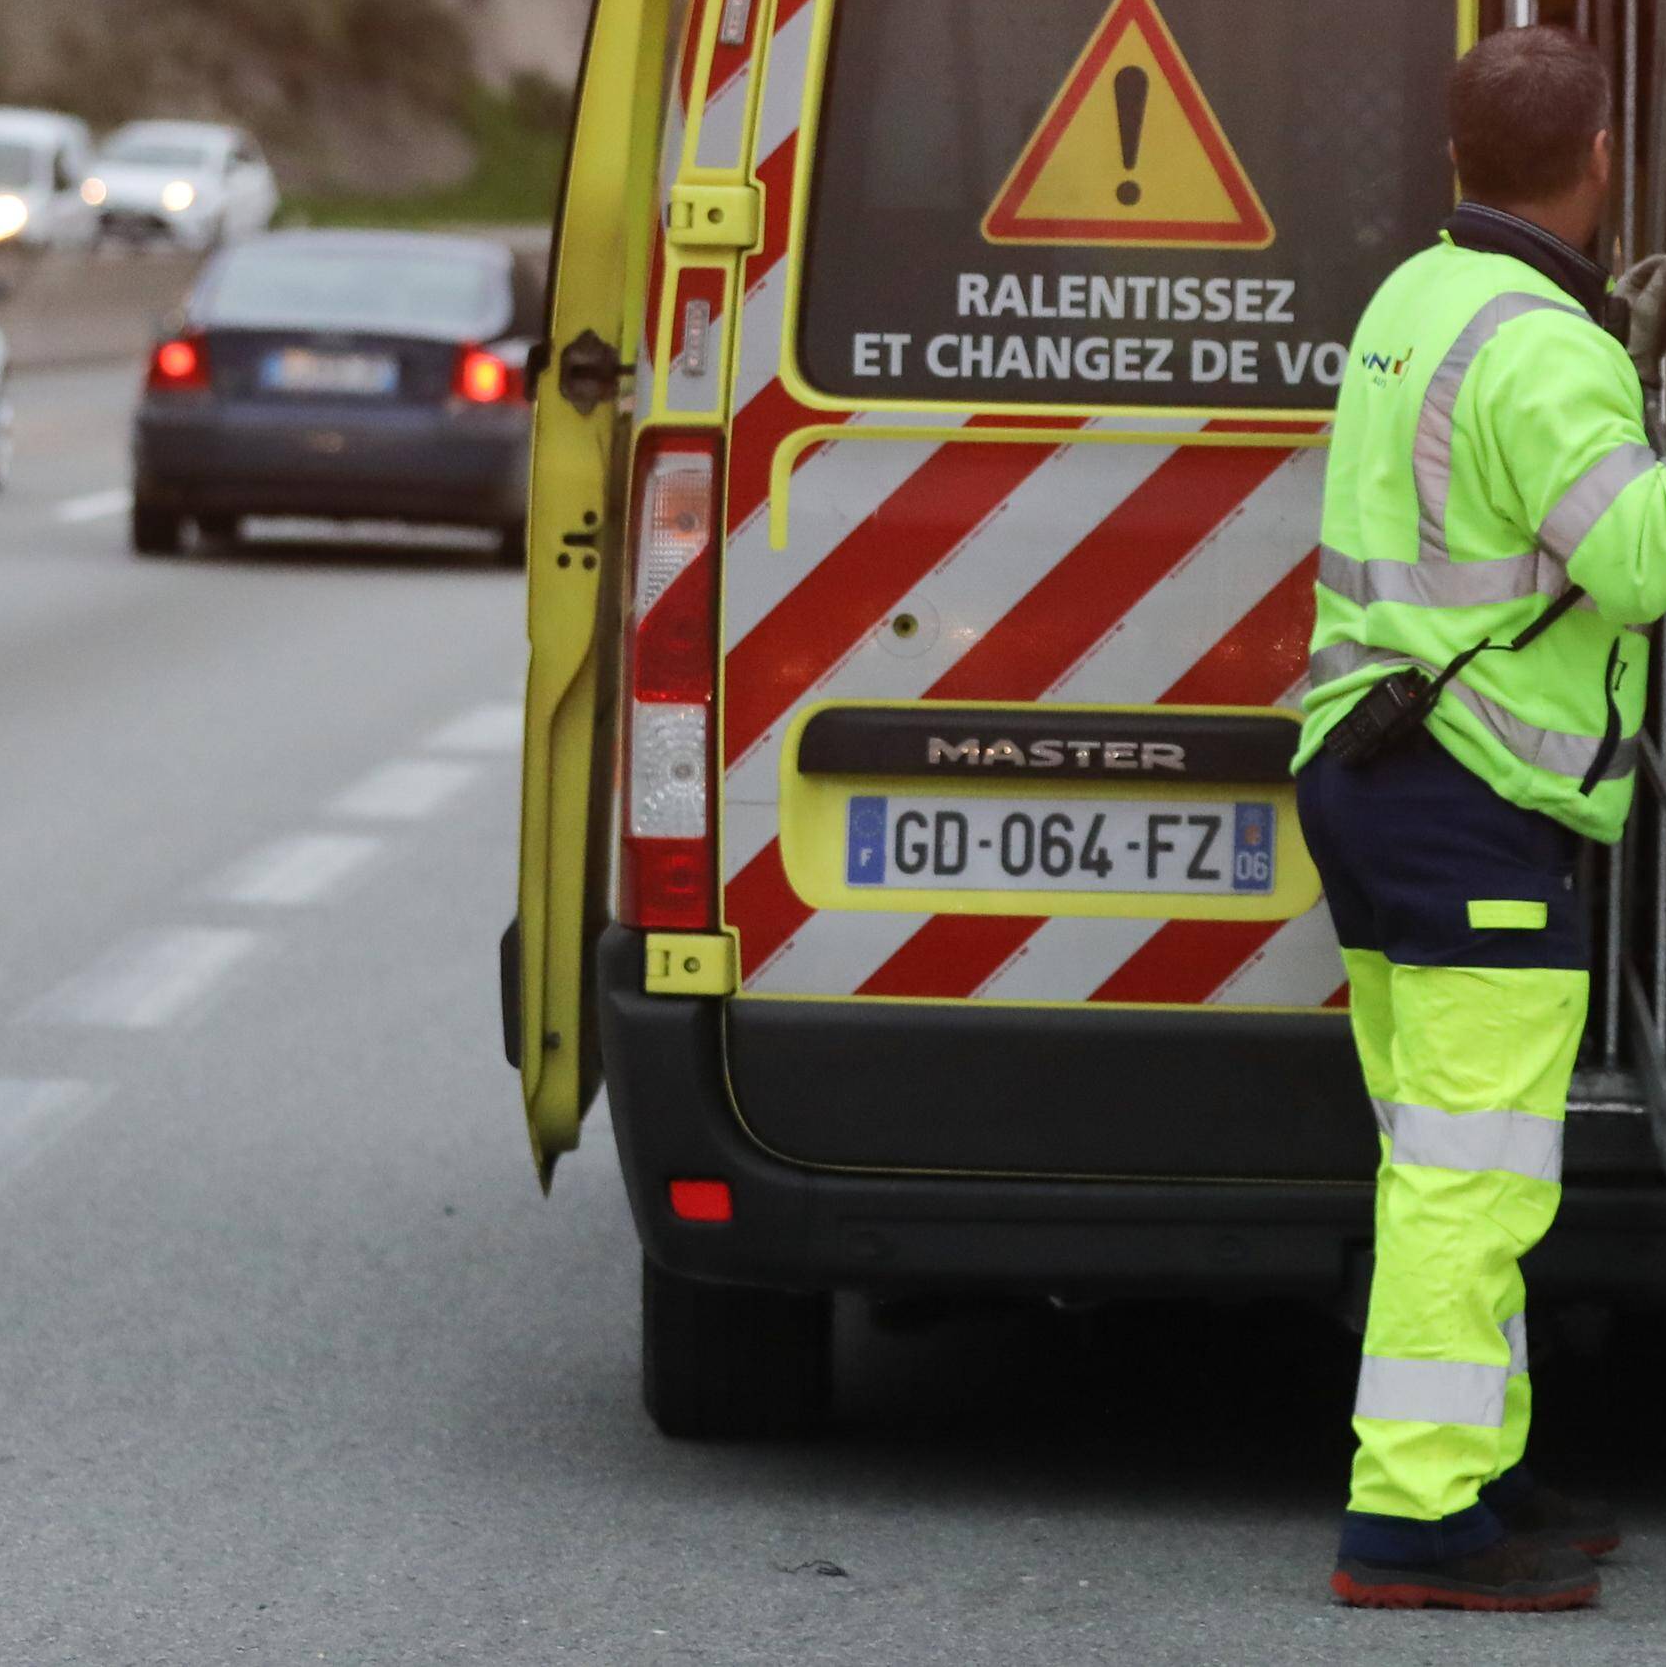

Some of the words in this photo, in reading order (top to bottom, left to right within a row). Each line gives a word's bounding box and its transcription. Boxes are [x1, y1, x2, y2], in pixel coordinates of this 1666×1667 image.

[956, 273, 1296, 323] RALENTISSEZ
[852, 333, 912, 376] ET
[925, 334, 1174, 383] CHANGEZ
[1190, 338, 1259, 384] DE
[927, 736, 1186, 771] MASTER
[860, 848, 873, 868] F
[894, 810, 1223, 881] GD-064-FZ
[1236, 852, 1269, 882] 06
